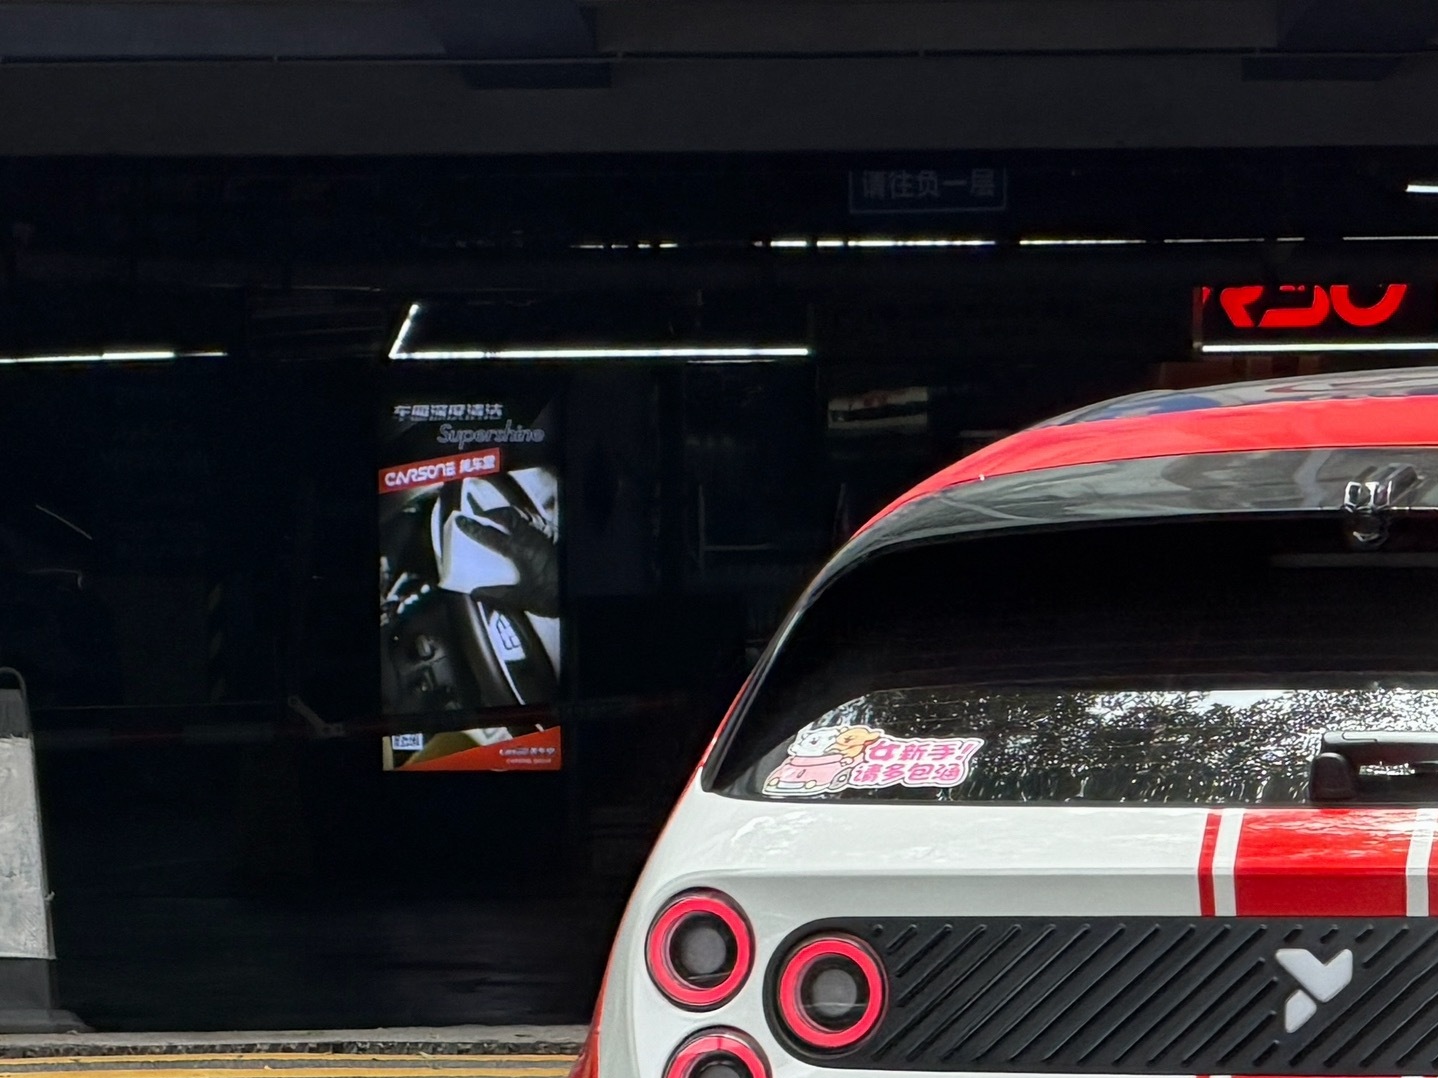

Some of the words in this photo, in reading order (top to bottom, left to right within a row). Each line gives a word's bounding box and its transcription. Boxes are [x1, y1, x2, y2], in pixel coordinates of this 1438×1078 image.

[436, 419, 546, 450] Supershine
[384, 461, 456, 487] CARSONE
[852, 762, 961, 783] 请多包涵
